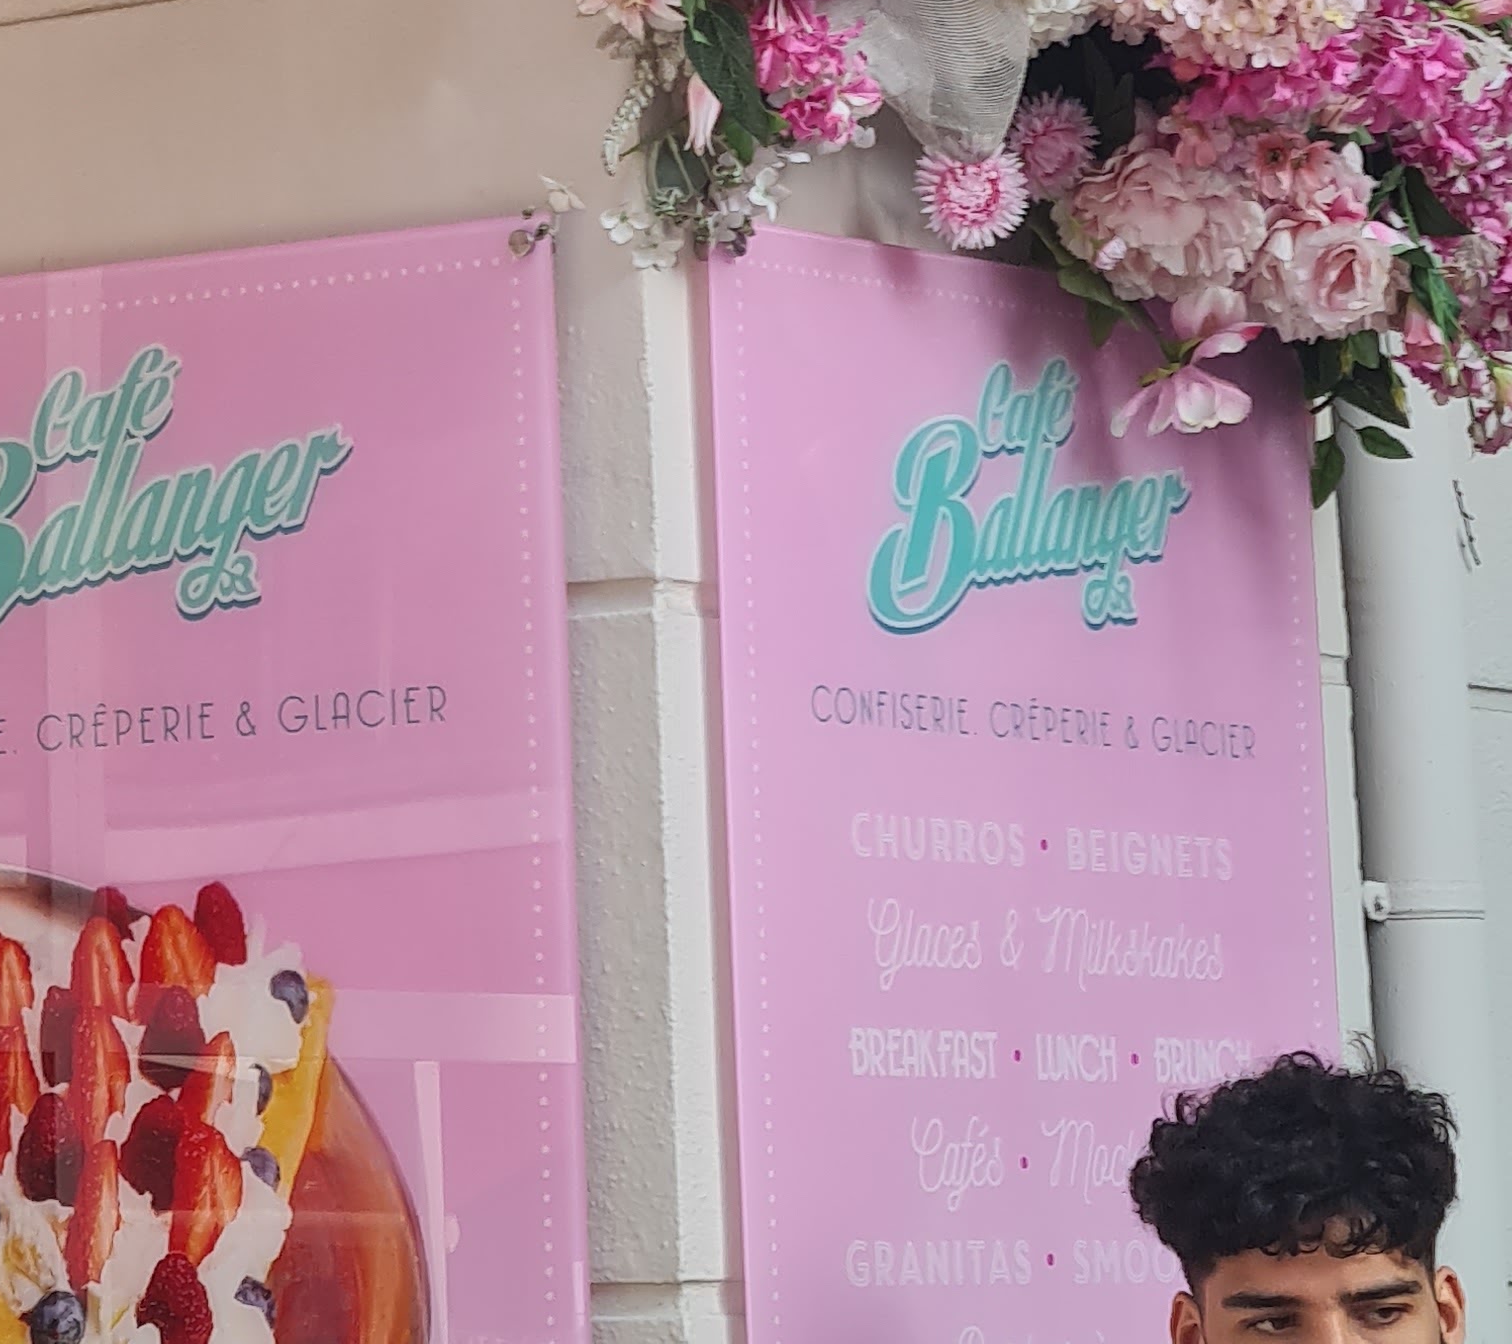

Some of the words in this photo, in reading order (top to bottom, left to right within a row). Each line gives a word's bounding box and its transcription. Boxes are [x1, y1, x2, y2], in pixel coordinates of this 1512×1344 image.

[32, 343, 183, 473] Café
[977, 355, 1079, 457] Café
[866, 414, 1192, 635] Ballanger
[36, 702, 216, 753] CRÊPERIE
[235, 701, 258, 738] &
[277, 685, 448, 734] GLACIER
[1124, 715, 1140, 749] &
[1151, 716, 1257, 760] GLACIER
[851, 812, 1028, 866] CHURROS
[1065, 826, 1234, 881] BEIGNETS
[867, 897, 983, 991] Glaces
[1000, 909, 1025, 970] &
[1036, 906, 1224, 993] Milkshakes
[849, 1026, 999, 1079] BREAKFAST
[1035, 1032, 1118, 1082] LUNCH
[1153, 1036, 1255, 1084] BRUNCH
[911, 1115, 1005, 1211] Cafés
[845, 1239, 1033, 1287] GRANITAS
